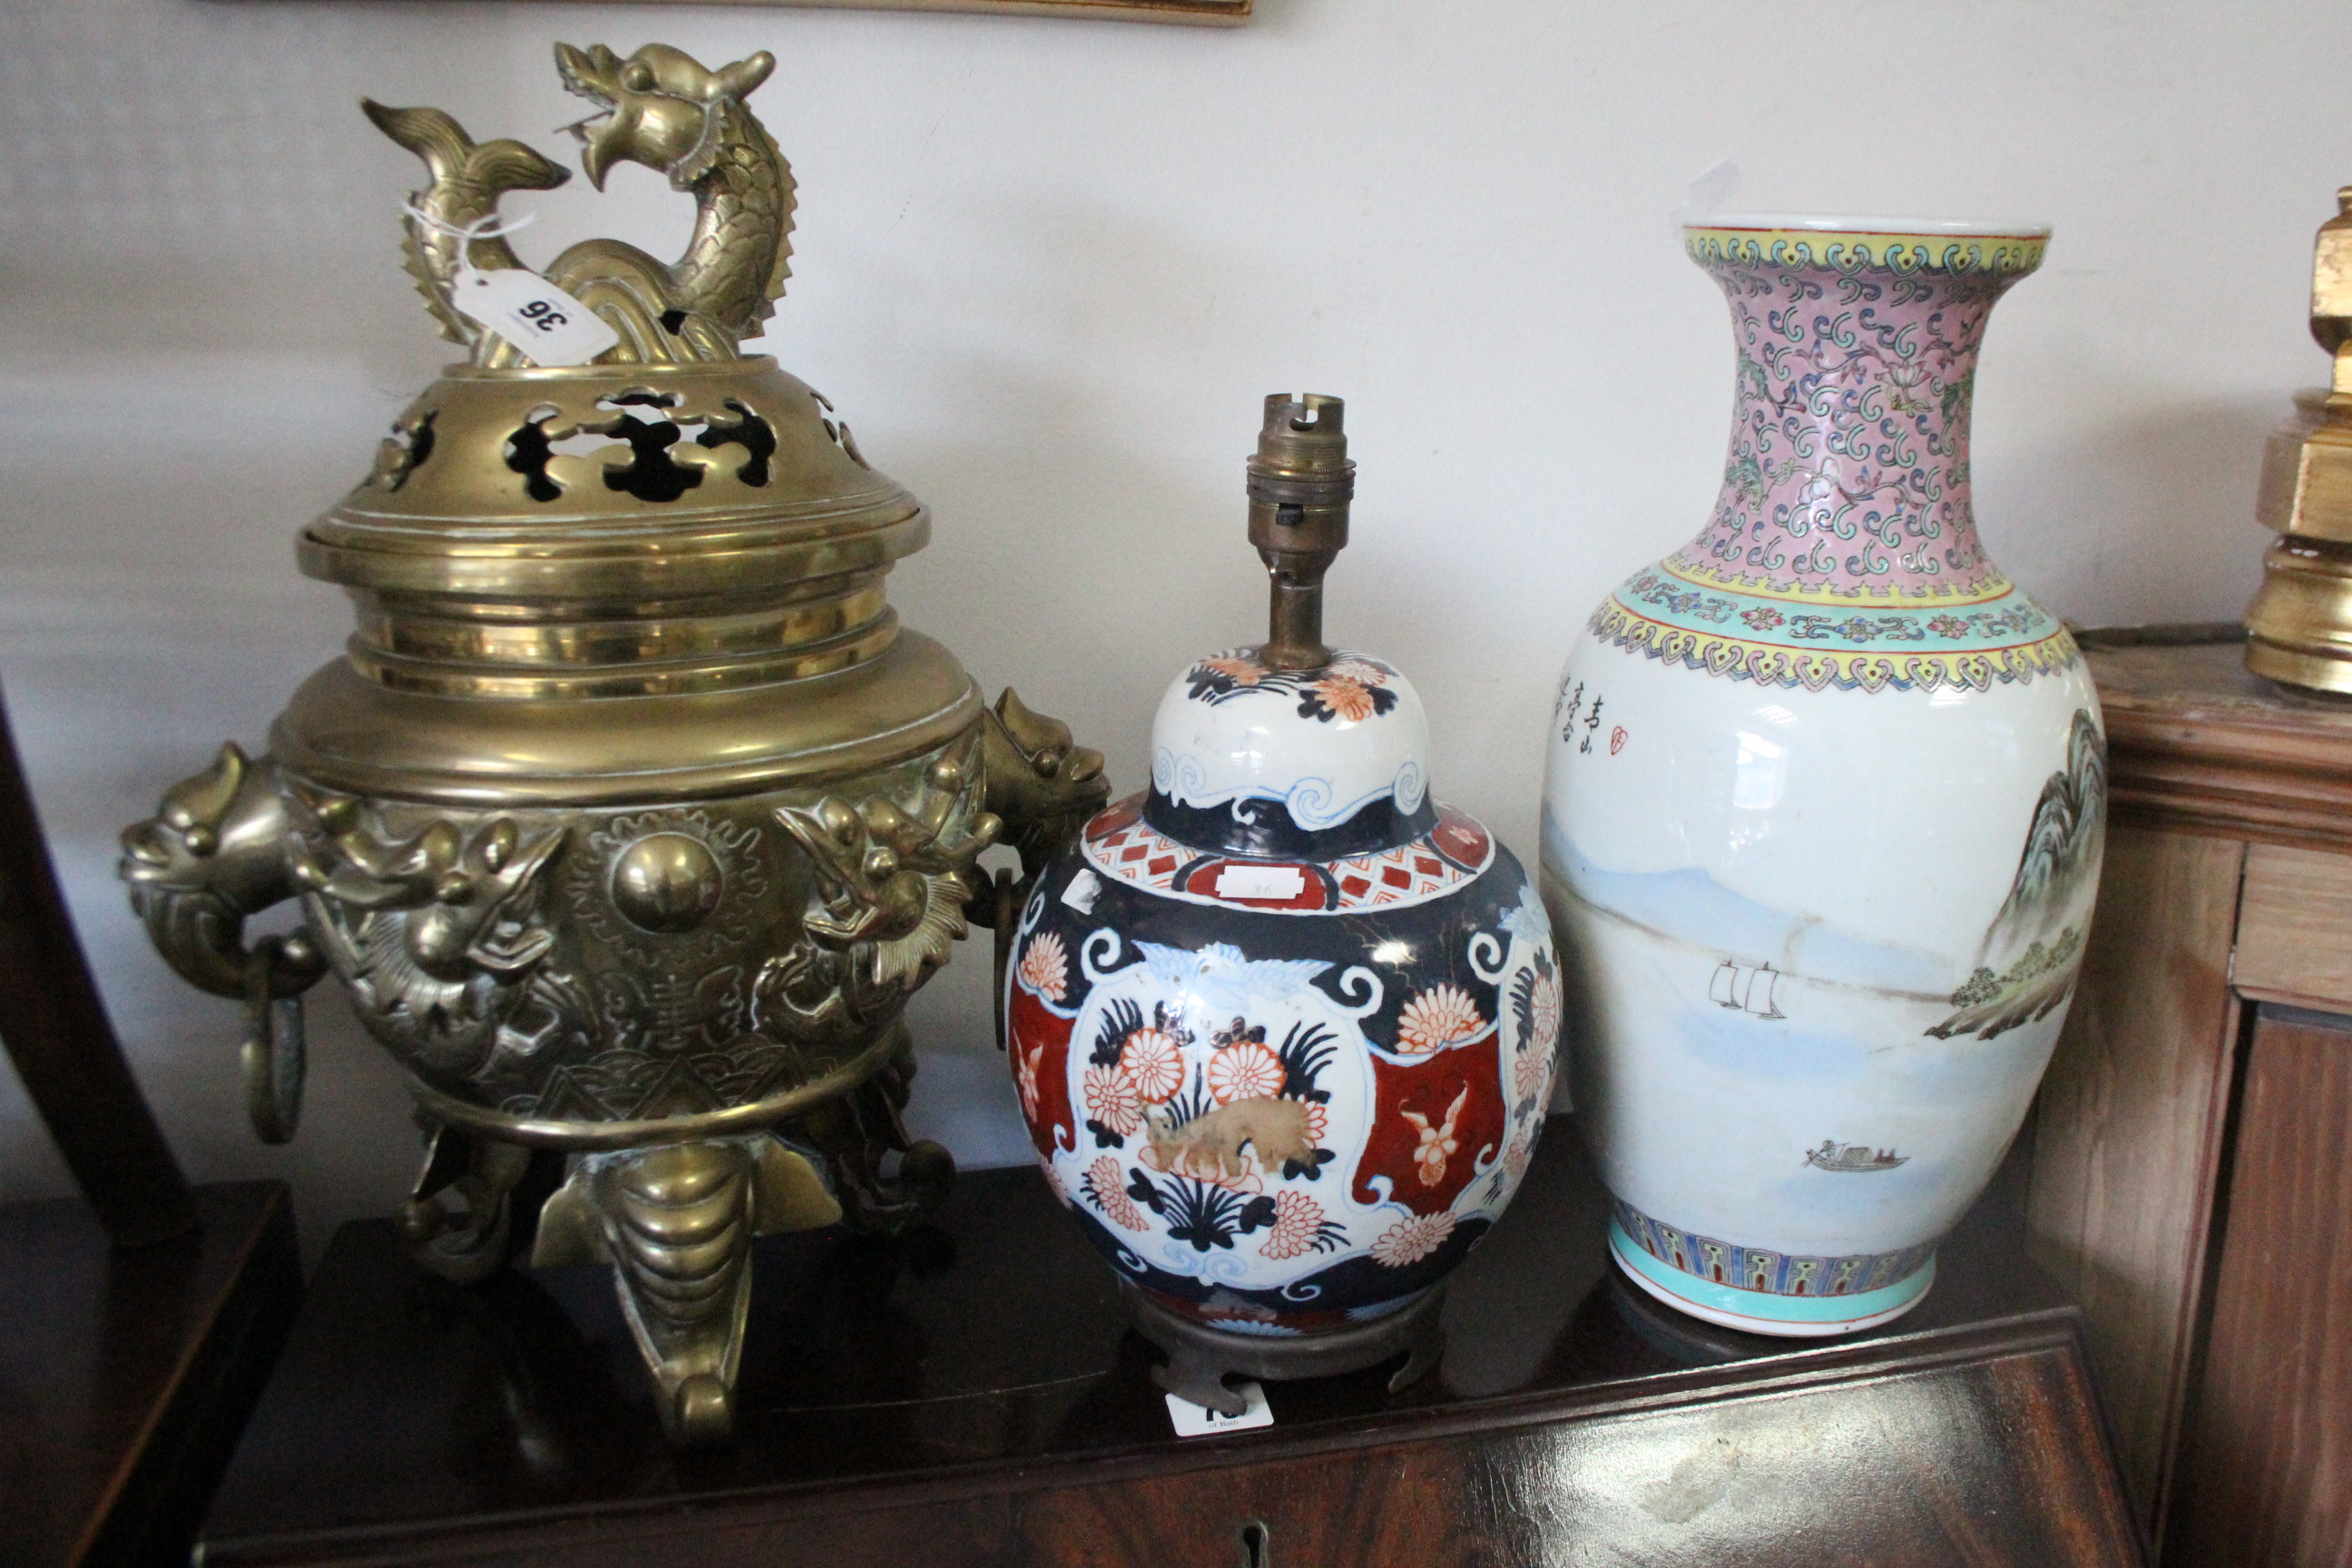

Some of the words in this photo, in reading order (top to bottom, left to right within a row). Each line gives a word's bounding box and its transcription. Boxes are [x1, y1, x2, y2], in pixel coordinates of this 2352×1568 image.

[519, 300, 568, 332] 36
[1253, 883, 1272, 897] 36
[1220, 1419, 1240, 1428] Bath
